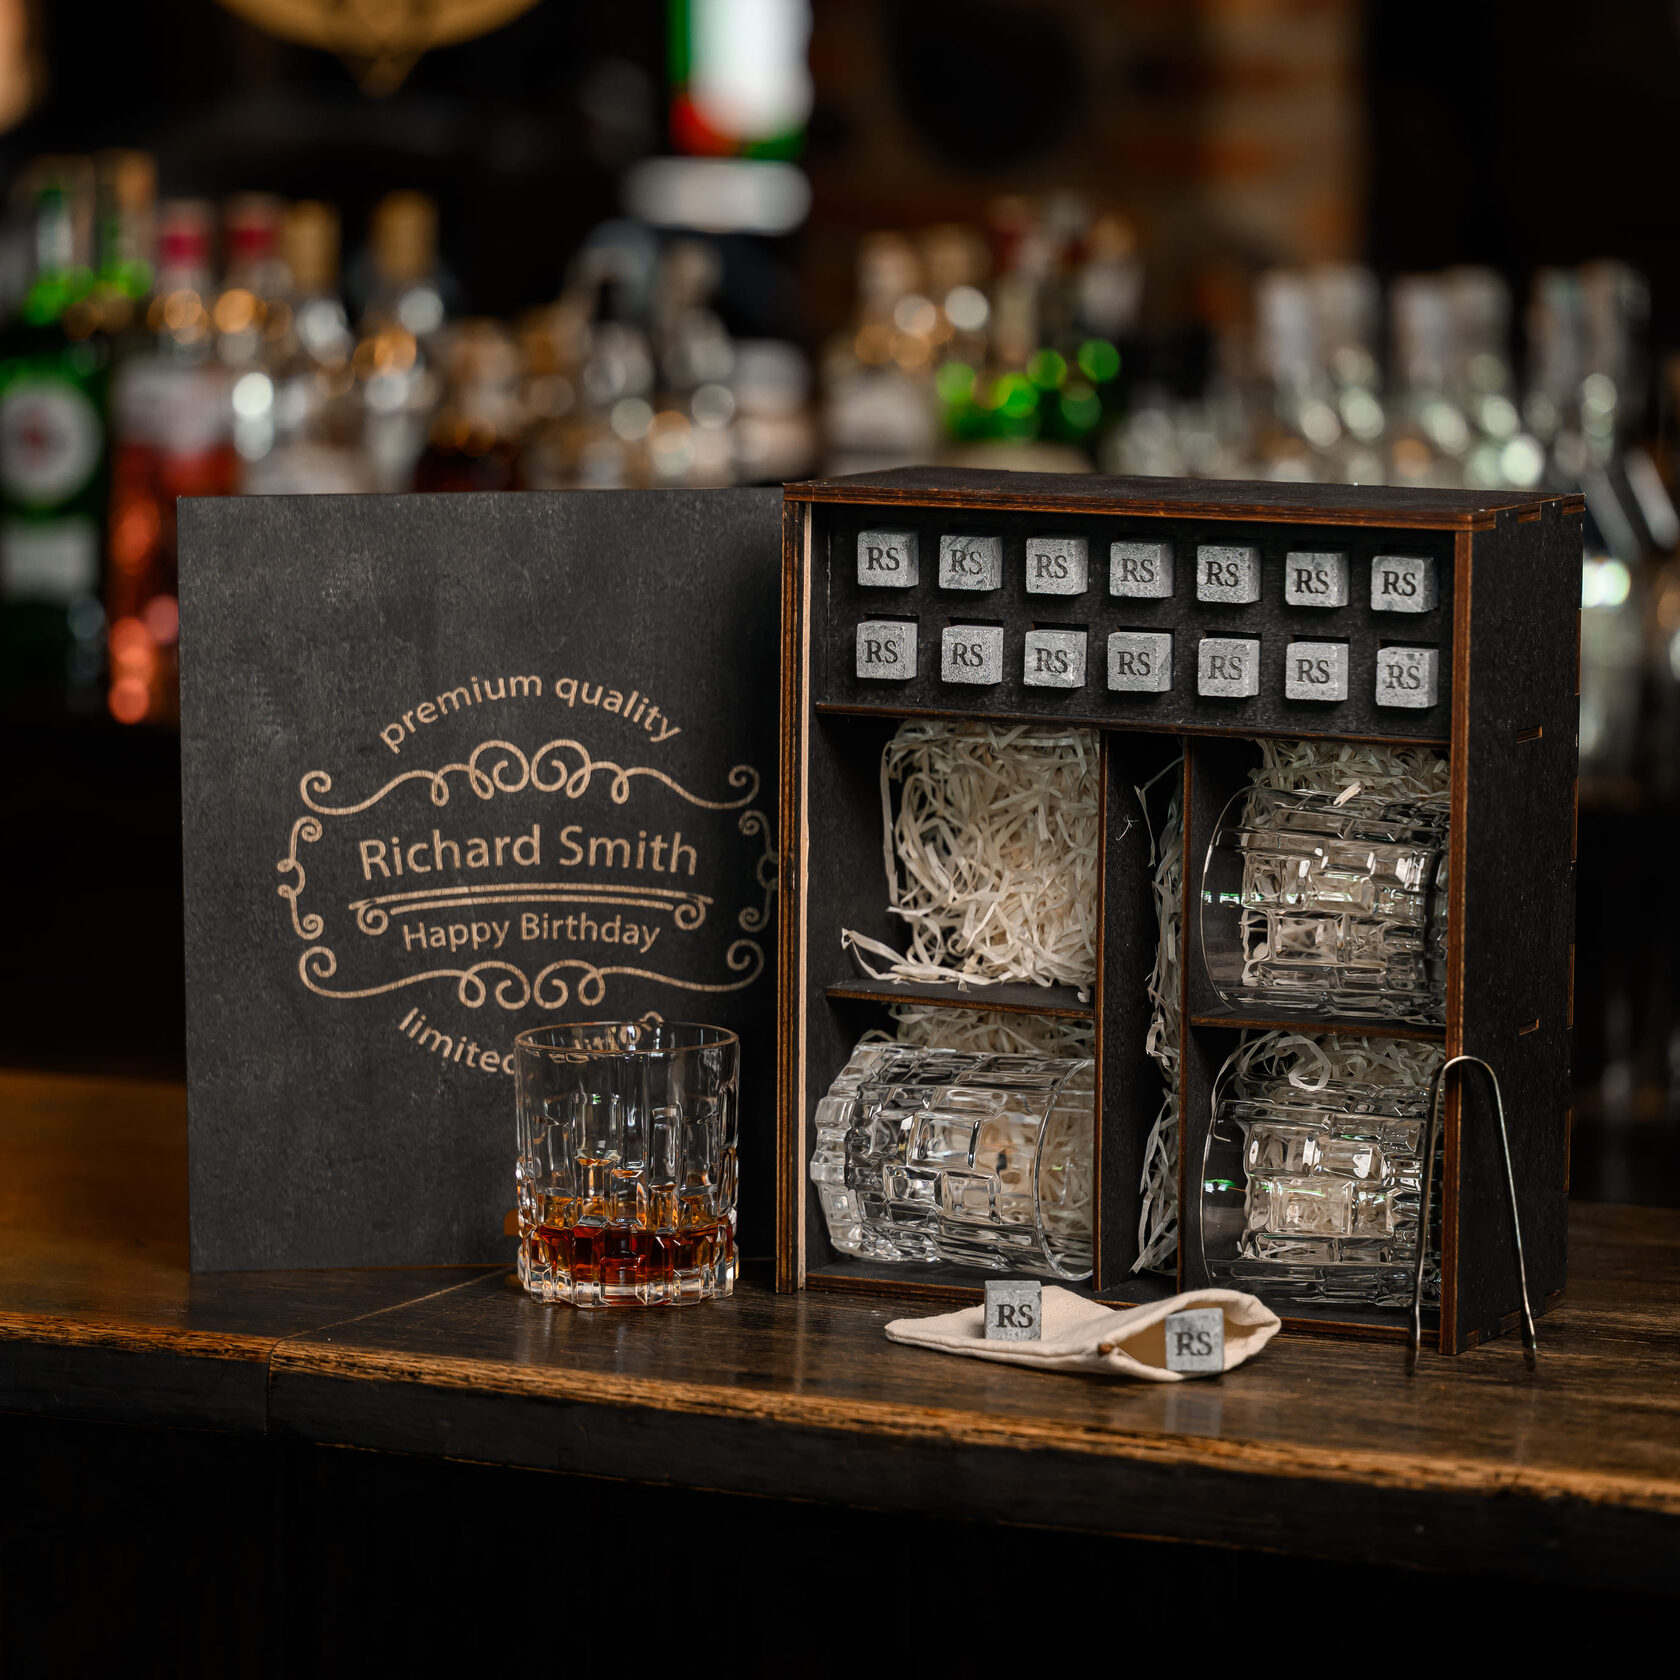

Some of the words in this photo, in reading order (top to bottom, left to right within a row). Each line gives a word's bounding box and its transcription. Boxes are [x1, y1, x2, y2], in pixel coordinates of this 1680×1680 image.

[866, 546, 900, 571] RS
[949, 549, 983, 576] RS
[1035, 553, 1069, 579] RS
[1121, 558, 1155, 583] RS
[1205, 561, 1239, 588] RS
[1294, 568, 1329, 594] RS
[1381, 570, 1416, 597] RS
[864, 639, 898, 664] RS
[951, 642, 984, 668] RS
[1034, 647, 1068, 674] RS
[1117, 651, 1151, 676] RS
[1208, 655, 1243, 681] RS
[1296, 658, 1330, 684] RS
[1386, 664, 1421, 690] RS
[380, 675, 543, 754] premium
[555, 676, 682, 743] quality
[359, 824, 541, 880] Richard
[559, 825, 698, 876] Smith
[403, 916, 509, 952] Happy
[521, 912, 661, 953] Birthday
[997, 1303, 1034, 1329] RS
[1175, 1331, 1213, 1357] RS
